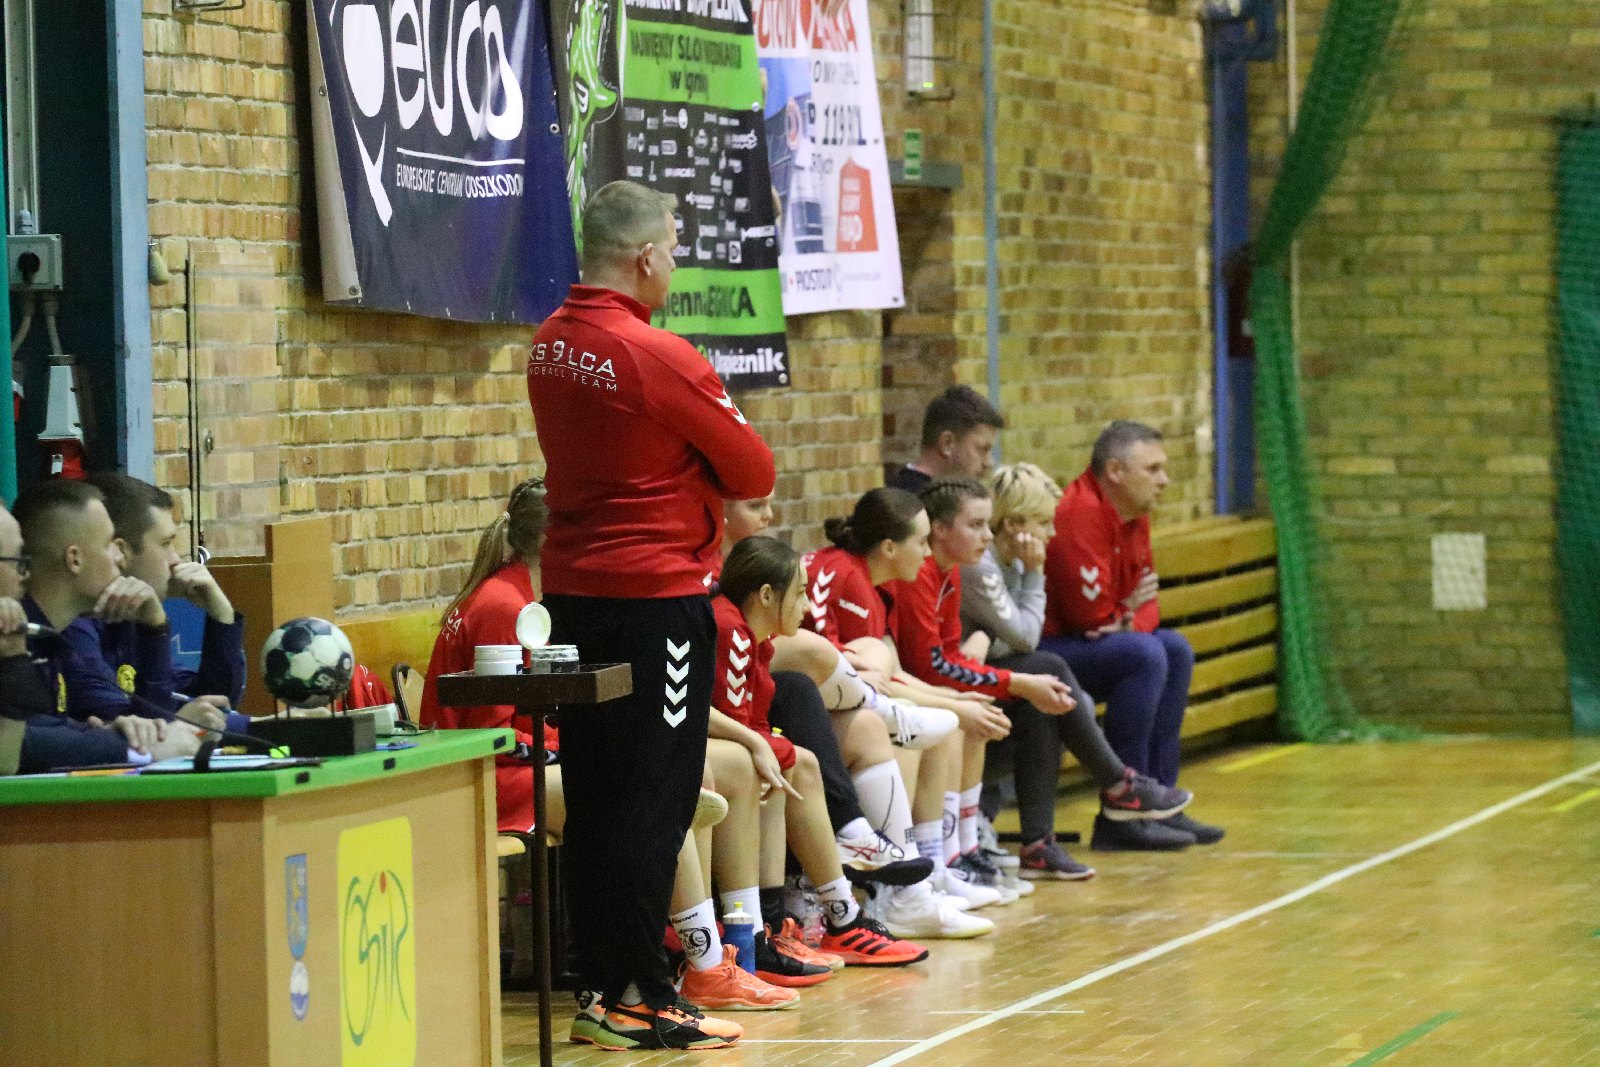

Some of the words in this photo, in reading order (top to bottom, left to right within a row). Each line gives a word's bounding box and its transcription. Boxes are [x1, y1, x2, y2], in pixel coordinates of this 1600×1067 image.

[552, 340, 565, 362] 9
[568, 347, 616, 378] LCA
[572, 372, 617, 393] TEAM
